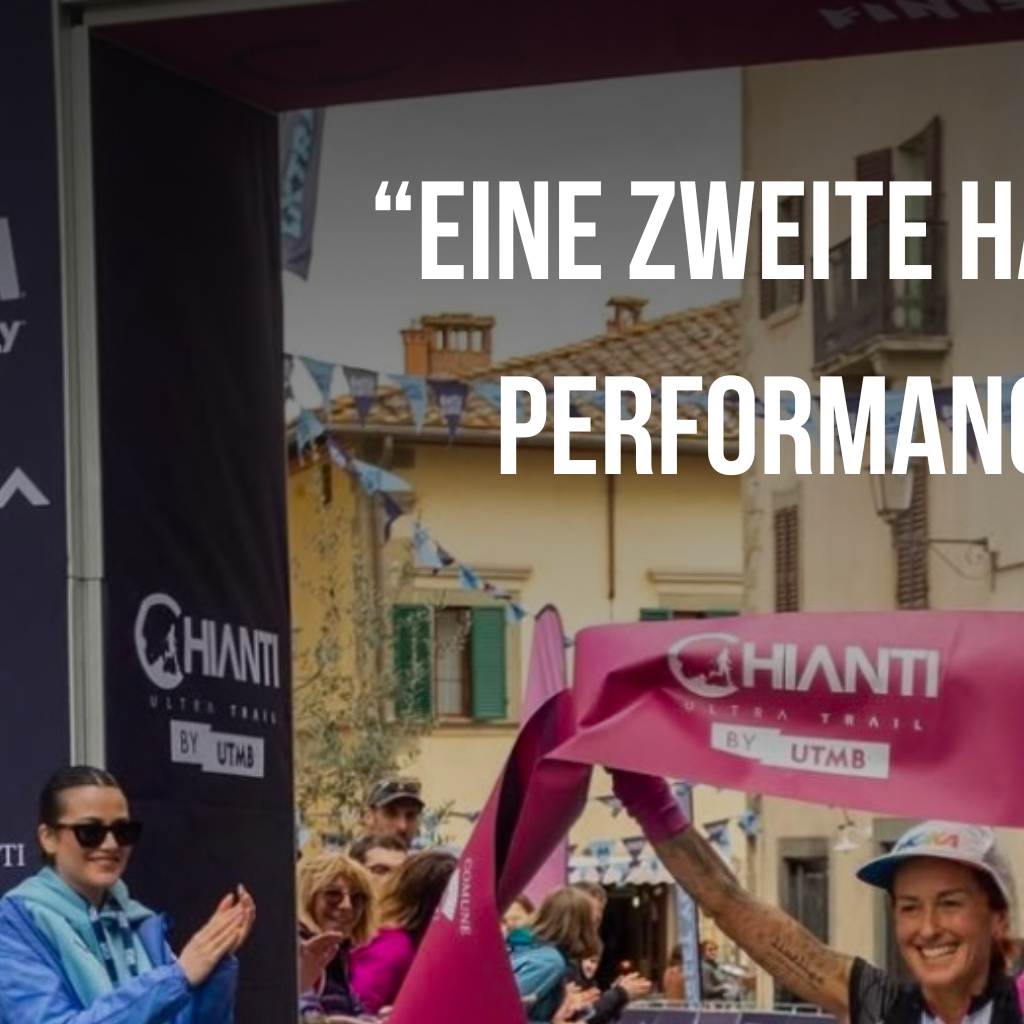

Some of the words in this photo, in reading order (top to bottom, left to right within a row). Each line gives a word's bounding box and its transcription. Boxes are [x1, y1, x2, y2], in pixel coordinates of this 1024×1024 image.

[134, 592, 281, 690] CHIANTI
[668, 632, 940, 698] CHIANTI
[684, 700, 788, 721] ULTRA
[820, 712, 923, 731] TRAIL
[179, 730, 199, 754] BY
[216, 741, 255, 769] UTMB
[725, 730, 757, 750] BY
[789, 743, 867, 770] UTMB
[459, 858, 474, 936] COMUNE
